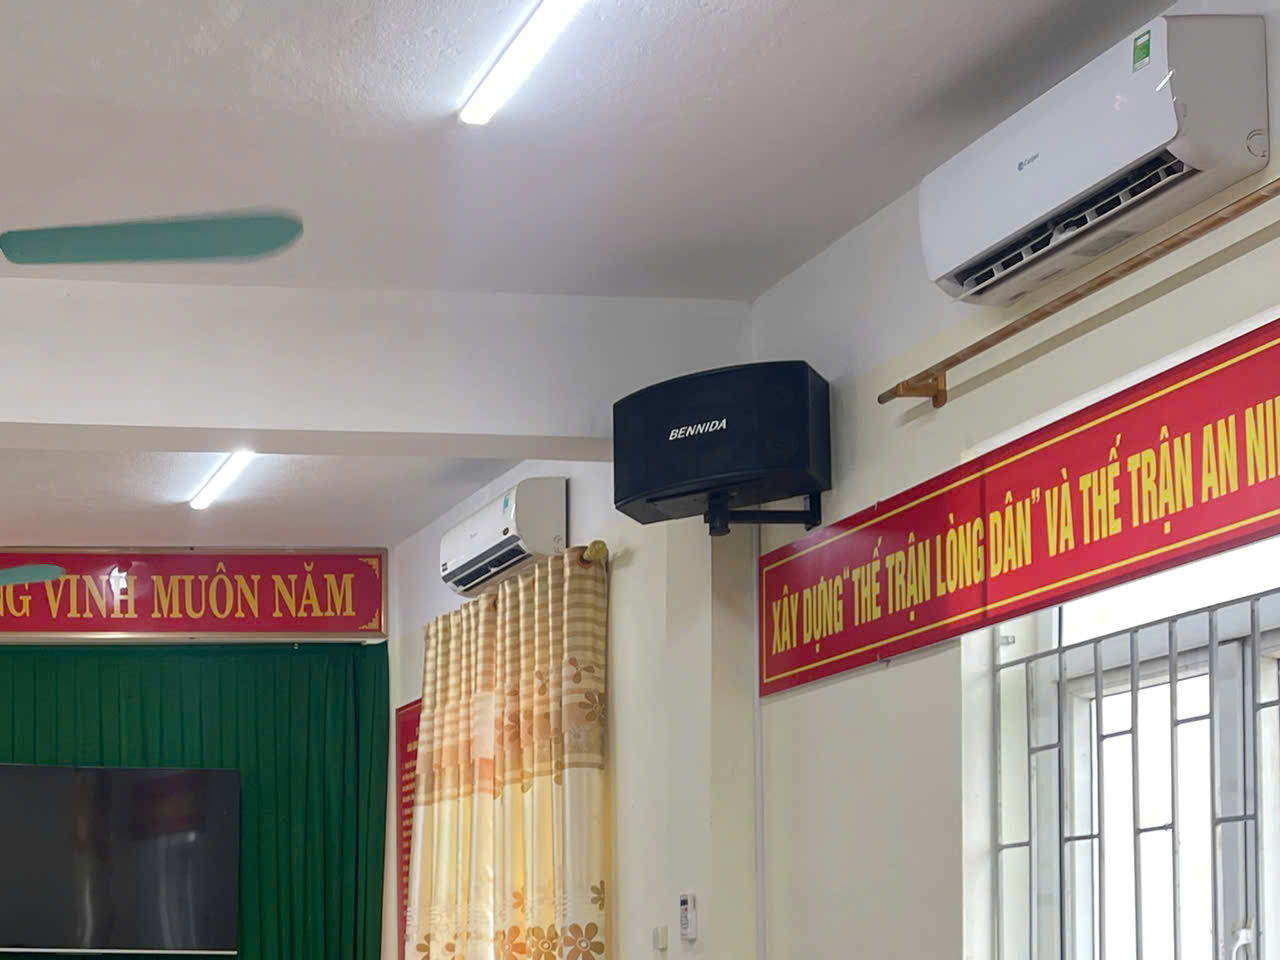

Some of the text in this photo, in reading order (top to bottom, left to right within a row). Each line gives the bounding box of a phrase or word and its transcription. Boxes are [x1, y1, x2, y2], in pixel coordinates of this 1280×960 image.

[669, 418, 727, 441] BENNIDA
[772, 584, 800, 656] XÂY
[885, 532, 931, 621] TRẬN
[936, 513, 985, 598] LÒNG
[1045, 467, 1075, 558] VÀ
[1079, 433, 1122, 545] THẾ
[1127, 425, 1194, 535] TRẬN
[1201, 414, 1239, 504] AN
[1245, 395, 1280, 487] NI
[43, 573, 138, 619] VINH
[151, 561, 260, 619] MUÔN
[271, 561, 356, 618] NĂM
